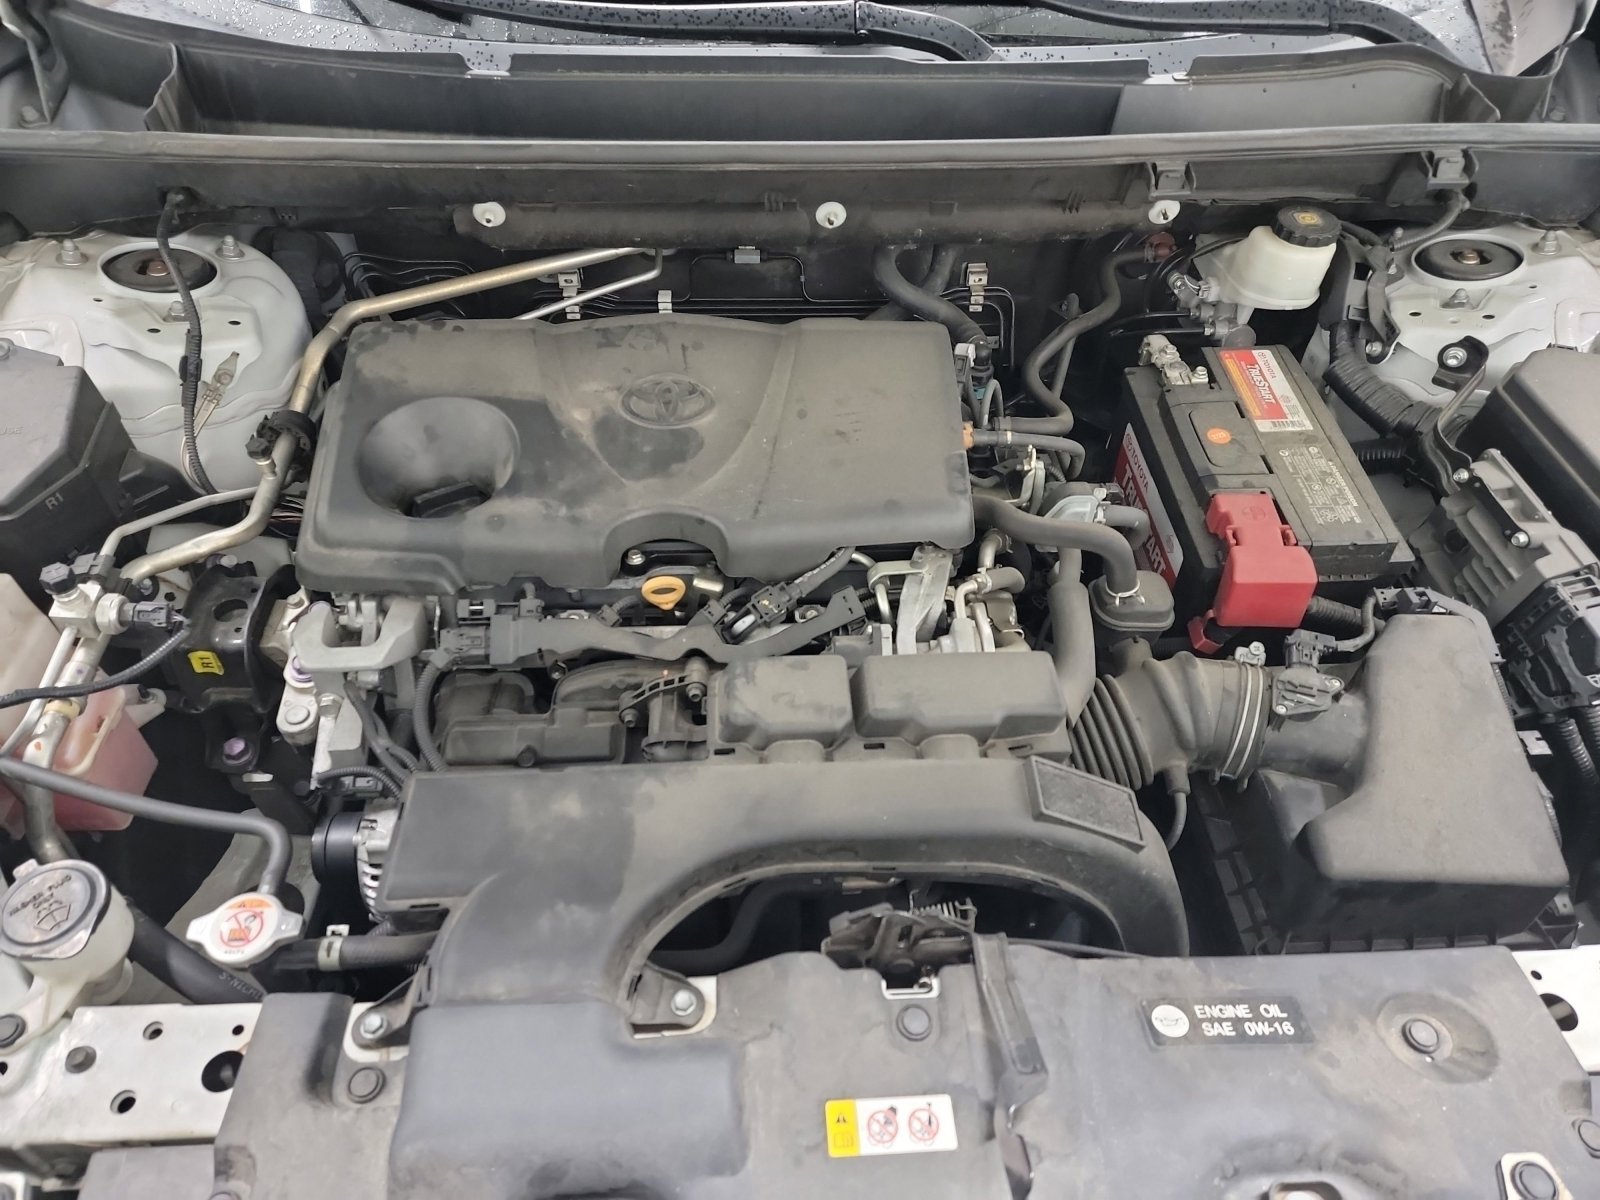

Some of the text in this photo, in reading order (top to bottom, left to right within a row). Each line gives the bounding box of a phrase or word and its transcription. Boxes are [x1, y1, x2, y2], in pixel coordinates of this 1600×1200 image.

[1264, 357, 1277, 379] TOYOTA
[1131, 449, 1149, 494] TOYOTA
[45, 492, 63, 509] R1
[199, 657, 215, 669] R1
[1194, 1003, 1288, 1019] ENGINE OIL
[1201, 1021, 1295, 1036] SAE 0W-16
